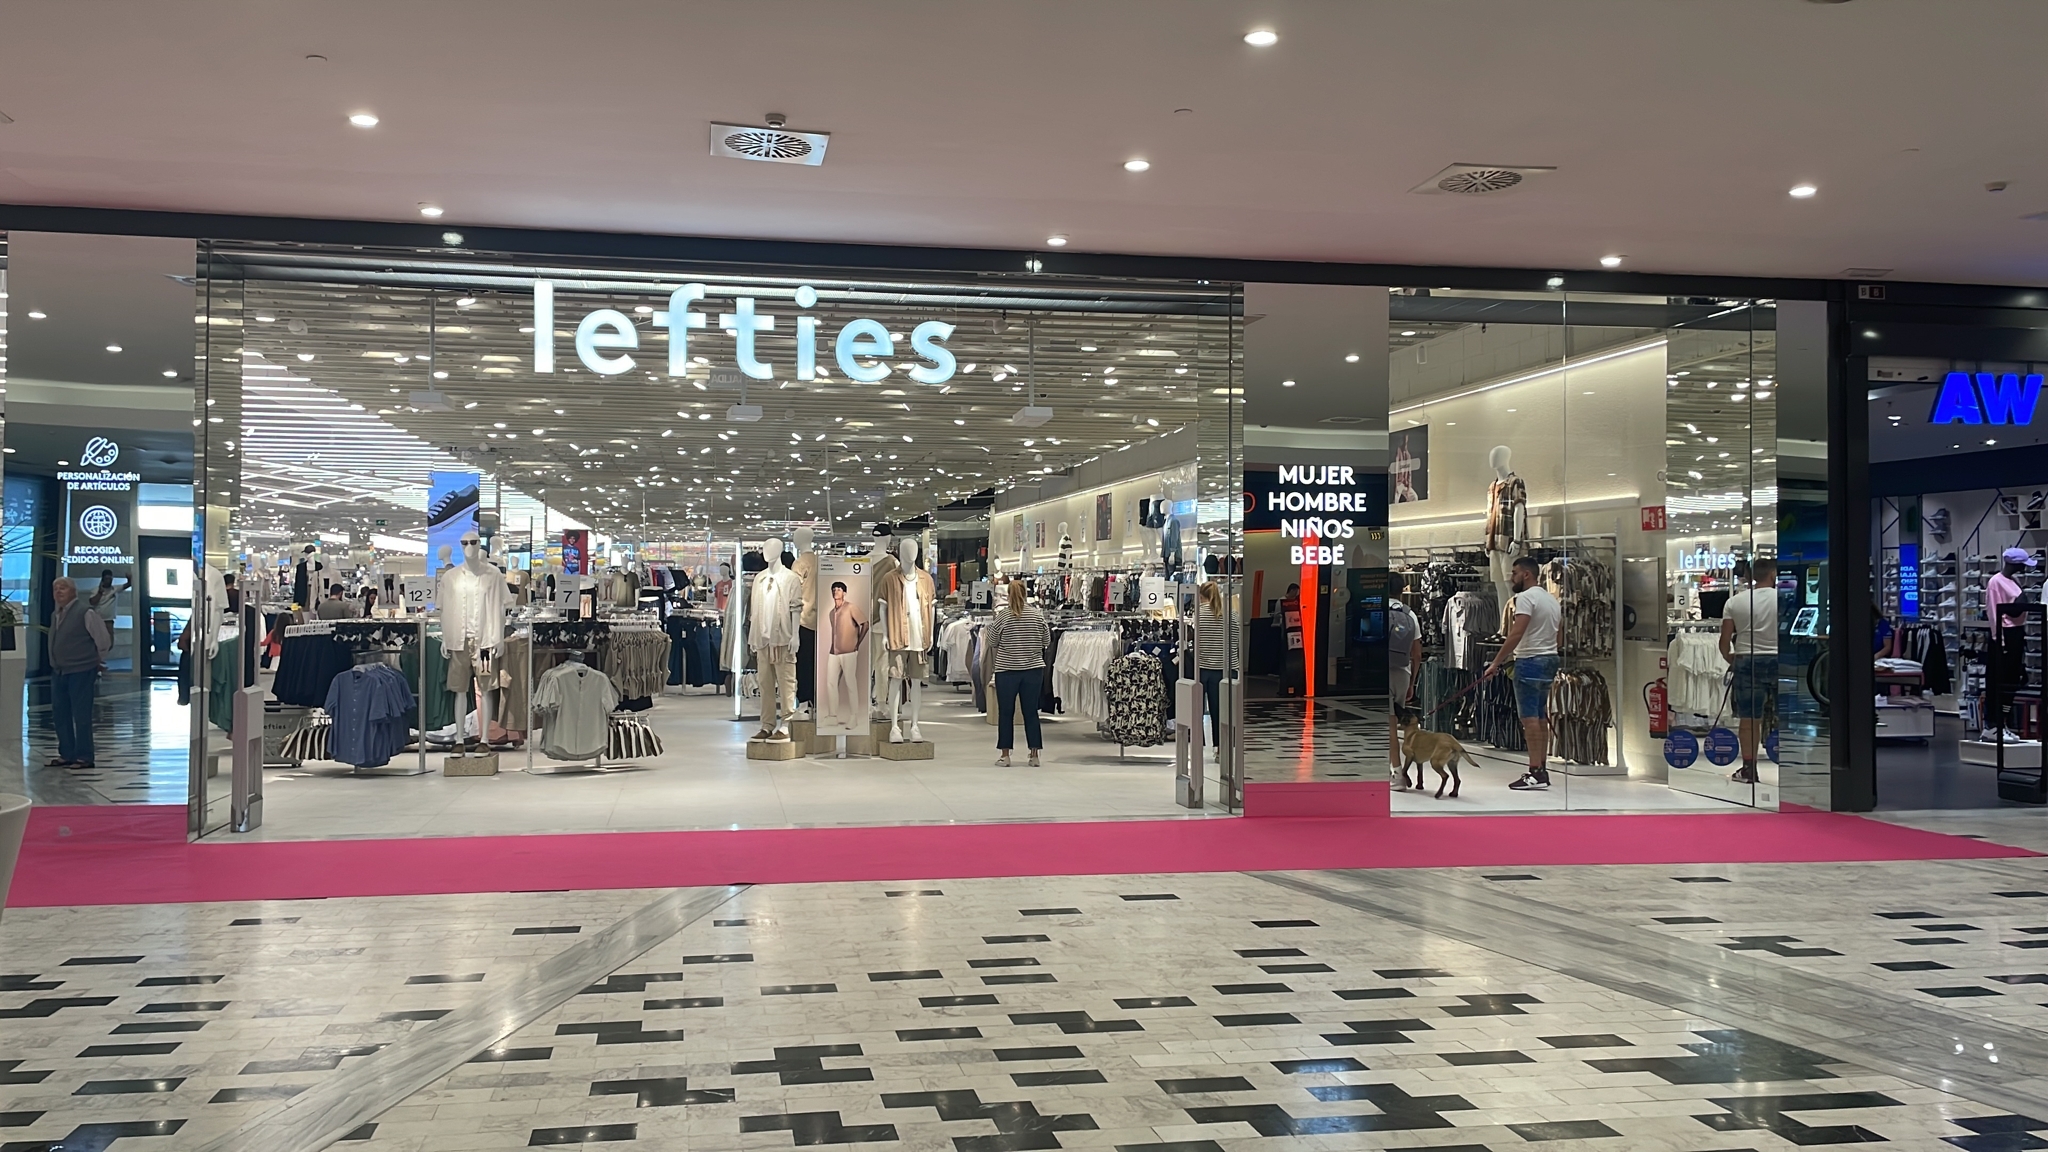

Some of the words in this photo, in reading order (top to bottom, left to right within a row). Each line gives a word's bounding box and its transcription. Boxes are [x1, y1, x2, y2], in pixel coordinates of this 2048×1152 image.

[533, 280, 957, 384] lefties
[1933, 371, 2044, 426] AW
[57, 471, 140, 482] PERSONALIZACIÓN
[1278, 464, 1356, 486] MUJER
[66, 481, 80, 490] DE
[80, 480, 131, 491] ARTÍCULOS
[1268, 491, 1367, 513] HOMBRE
[1280, 516, 1354, 539] NIÑOS
[74, 545, 121, 554] RECOGIDA
[1290, 543, 1345, 566] BEBÉ
[100, 556, 134, 564] ONLINE
[1679, 548, 1735, 569] lefties
[852, 562, 862, 575] 9
[408, 589, 423, 602] 12
[563, 590, 573, 603] 7
[975, 591, 983, 601] 5
[1113, 591, 1120, 601] 7
[1148, 592, 1158, 605] 9
